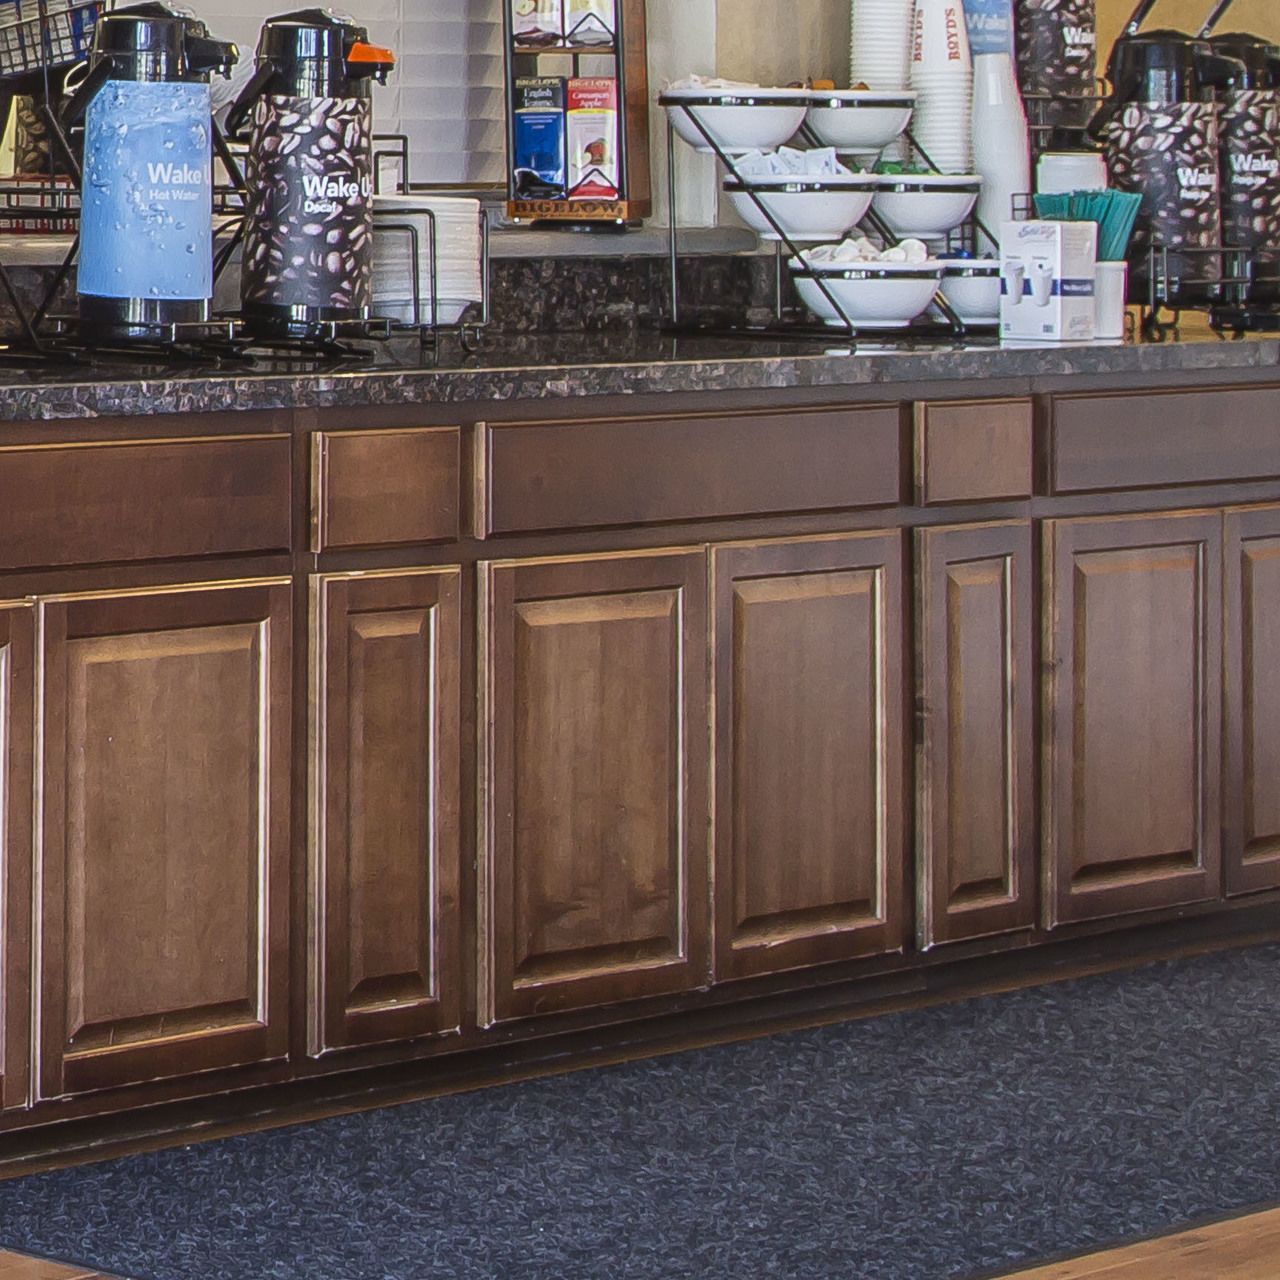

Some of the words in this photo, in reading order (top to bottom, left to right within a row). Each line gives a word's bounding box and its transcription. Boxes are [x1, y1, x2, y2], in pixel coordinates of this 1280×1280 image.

[146, 162, 202, 185] Wake
[303, 175, 360, 198] Wake
[148, 189, 170, 201] Hot
[170, 189, 201, 202] Water
[303, 200, 337, 214] Decaf
[515, 201, 619, 214] BIGELOW
